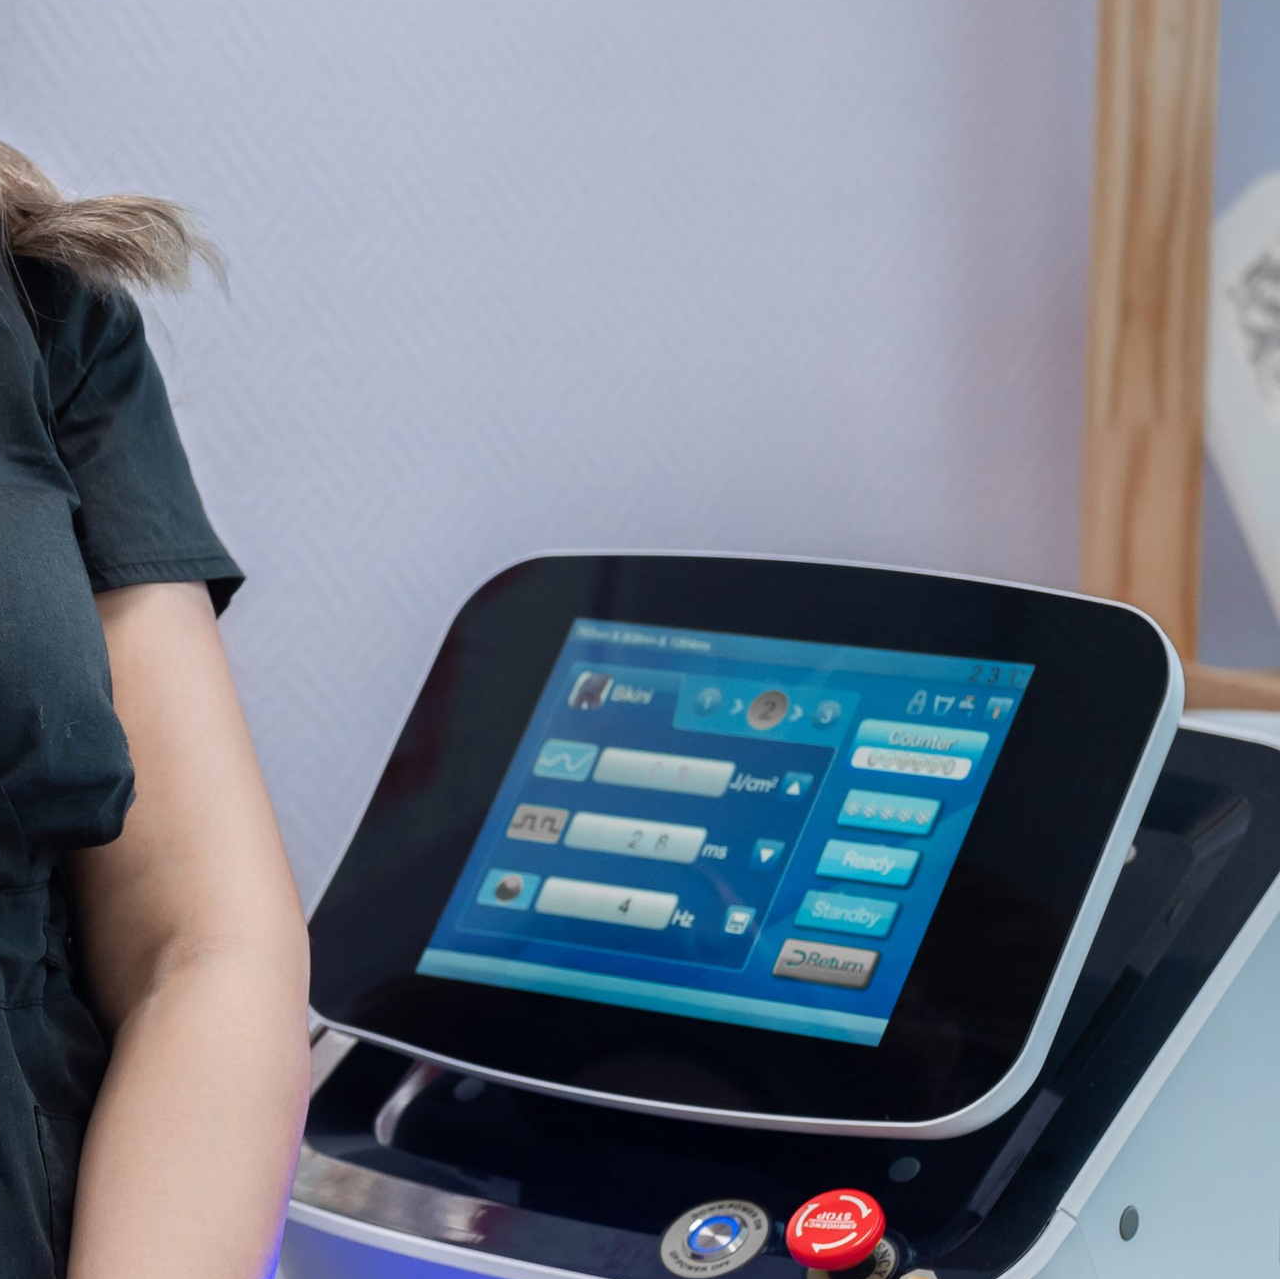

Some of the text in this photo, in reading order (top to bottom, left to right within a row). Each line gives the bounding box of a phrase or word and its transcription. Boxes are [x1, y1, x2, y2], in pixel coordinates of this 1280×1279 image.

[888, 728, 958, 751] Counter
[701, 843, 729, 860] ms
[841, 848, 896, 876] Ready
[618, 896, 695, 928] 4 Hz
[811, 899, 882, 929] Standby
[806, 950, 864, 974] Return
[802, 1220, 858, 1230] EMERGENCY
[815, 1211, 853, 1221] STOP
